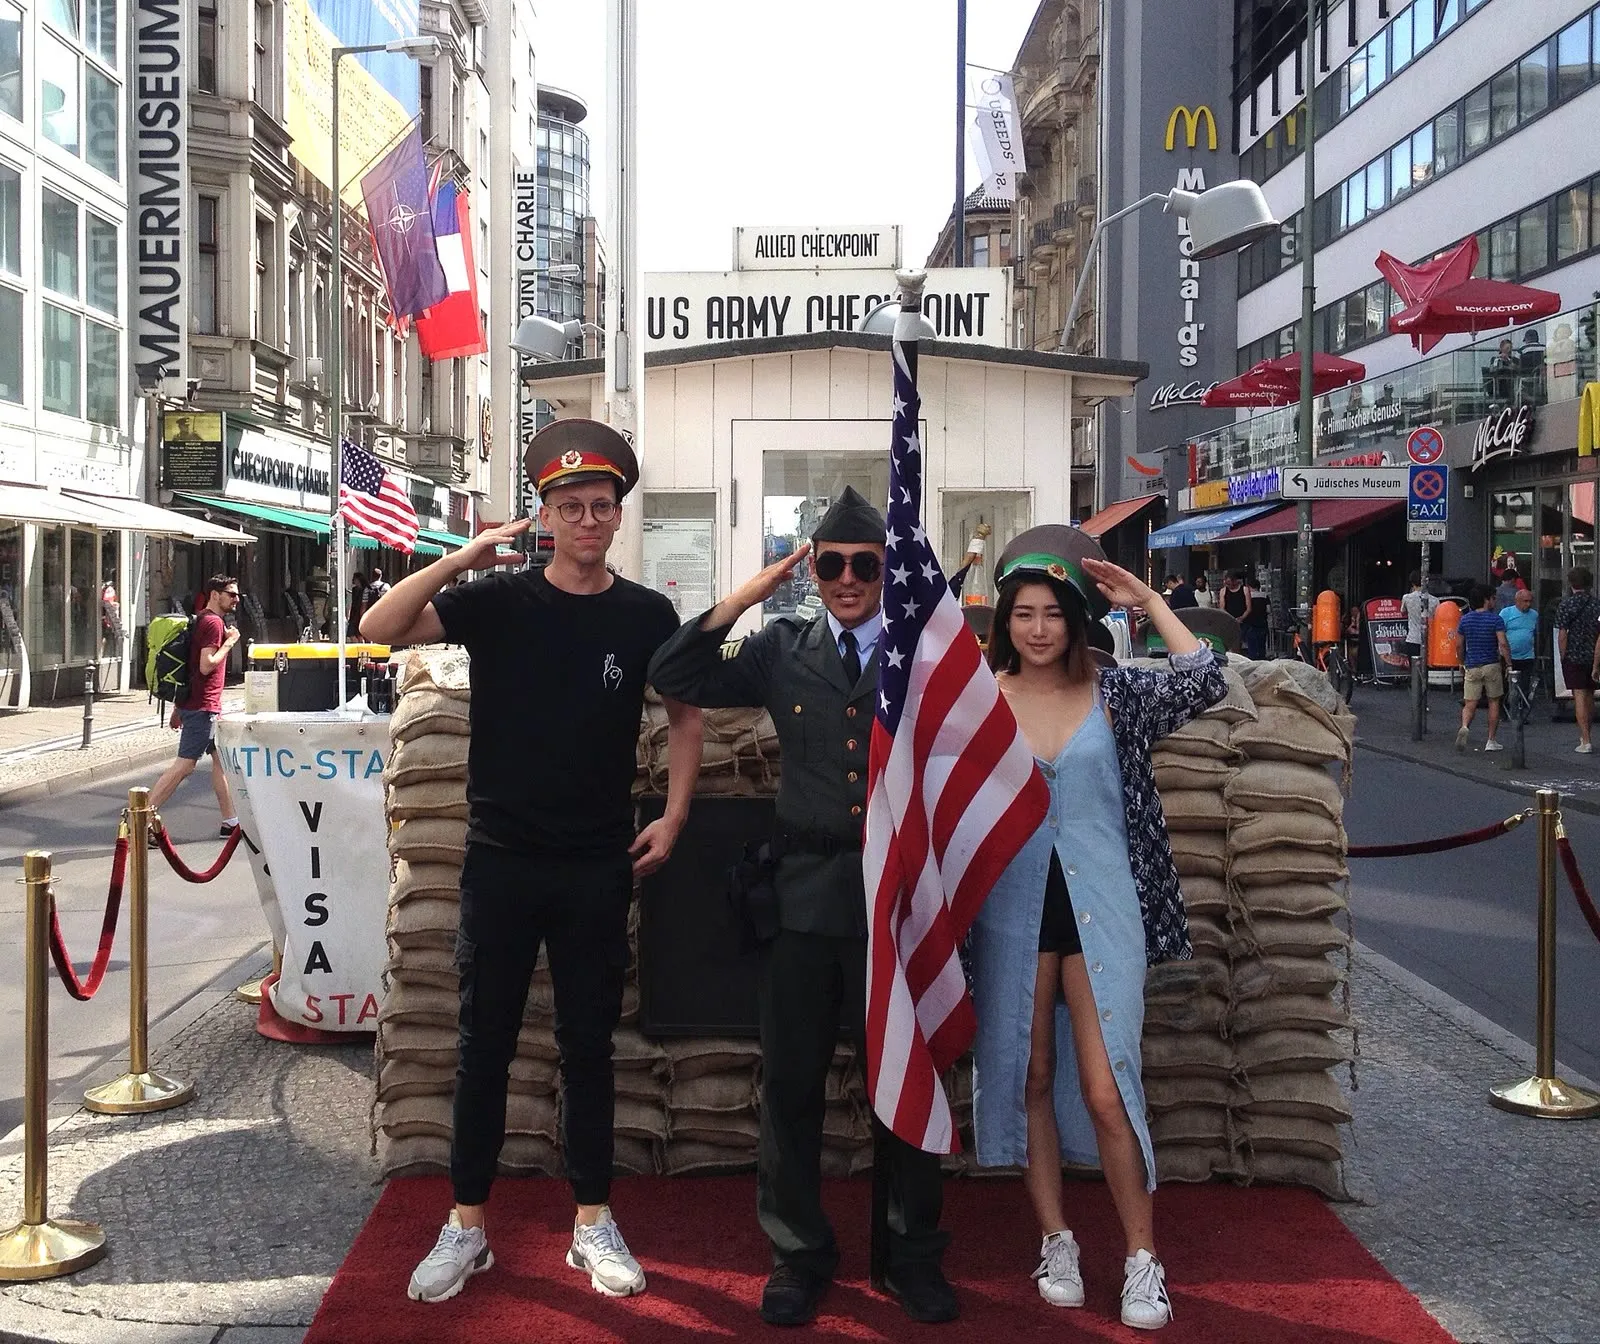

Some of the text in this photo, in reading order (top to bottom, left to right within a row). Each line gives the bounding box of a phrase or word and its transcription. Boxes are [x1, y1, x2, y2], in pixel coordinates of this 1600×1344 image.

[138, 0, 181, 378] MAUERMUSEUM
[516, 172, 535, 262] CHARLIE
[755, 233, 880, 258] ALLIED CHECKPOINT
[1177, 167, 1206, 367] Monald's
[648, 292, 990, 340] US ARMY CHEOINT
[1150, 380, 1219, 408] McCaf
[1472, 404, 1528, 465] McCafé
[231, 447, 294, 489] CHECKPOINT
[296, 463, 330, 497] CHARLIE
[1314, 478, 1401, 488] Jüdisches Museum
[1412, 503, 1443, 516] TAXI
[298, 801, 333, 975] VISA
